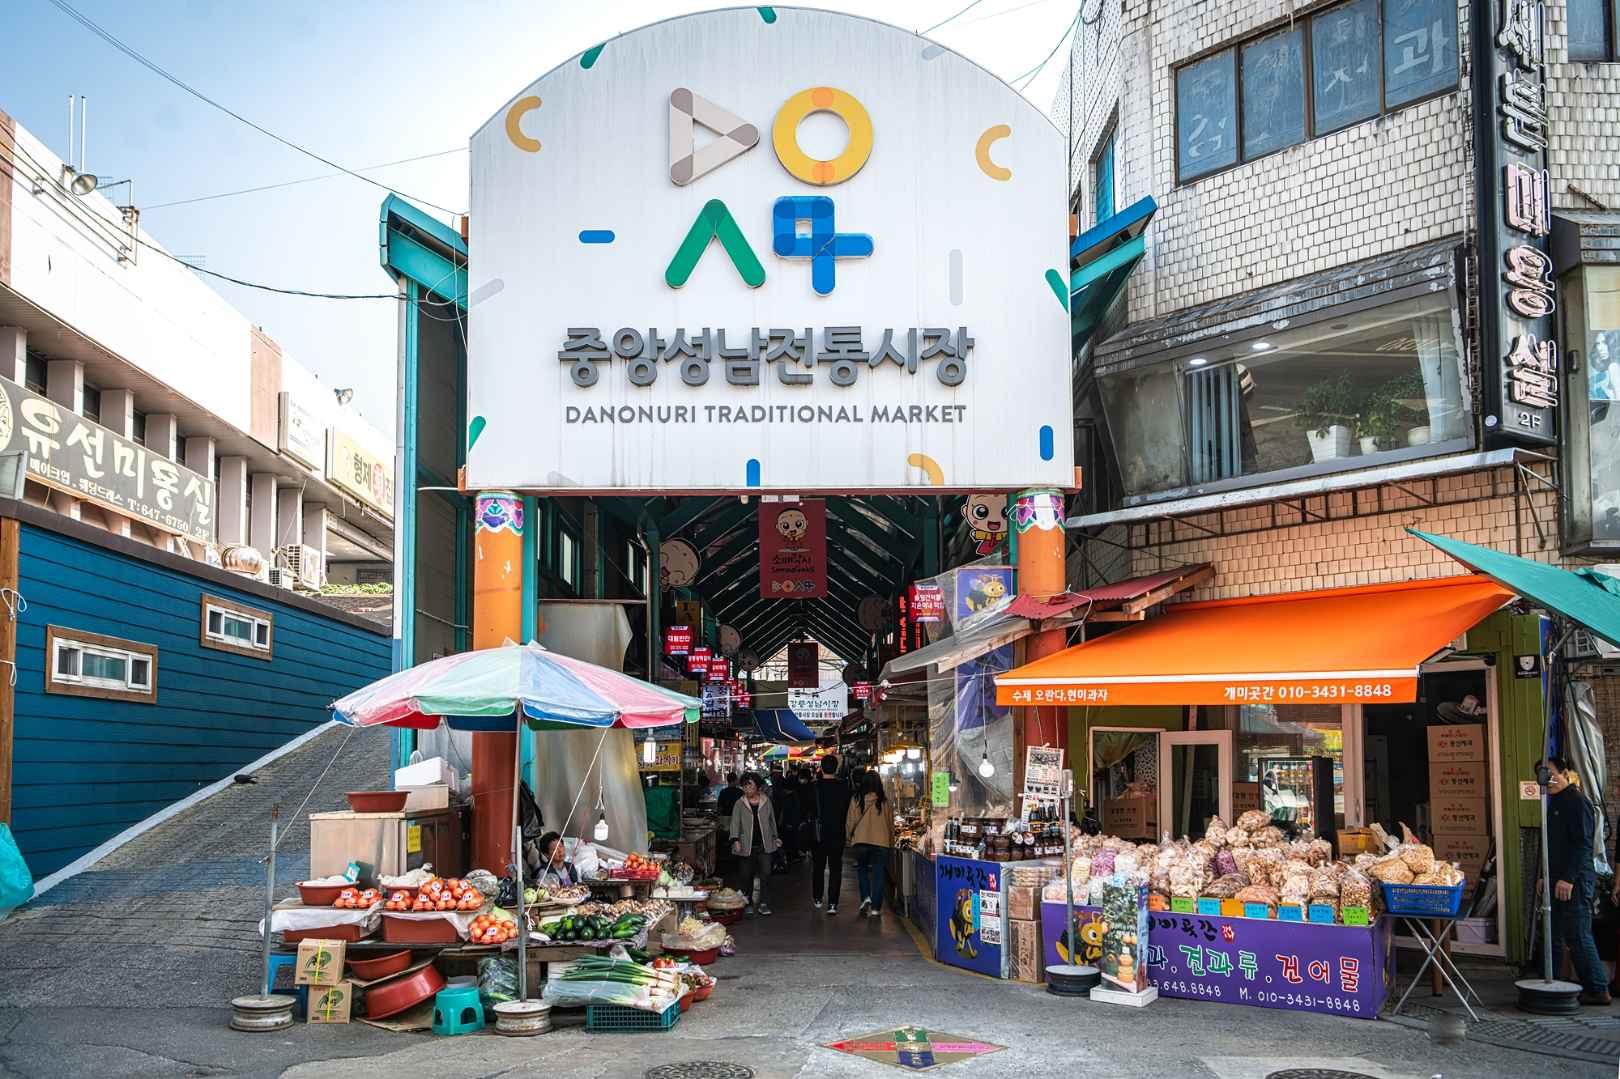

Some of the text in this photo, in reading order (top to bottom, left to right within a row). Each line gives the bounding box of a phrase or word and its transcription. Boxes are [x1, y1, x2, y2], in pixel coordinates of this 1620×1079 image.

[557, 325, 977, 388] 중앙성남전통시장
[565, 403, 968, 425] DANONURI TRADITIONAL MARKET
[1519, 412, 1543, 429] 2F
[21, 398, 213, 526] 유선미용실
[1224, 684, 1392, 702] 개미곳간 010-3431-8848
[1257, 990, 1361, 1012] 010-3431-8848
